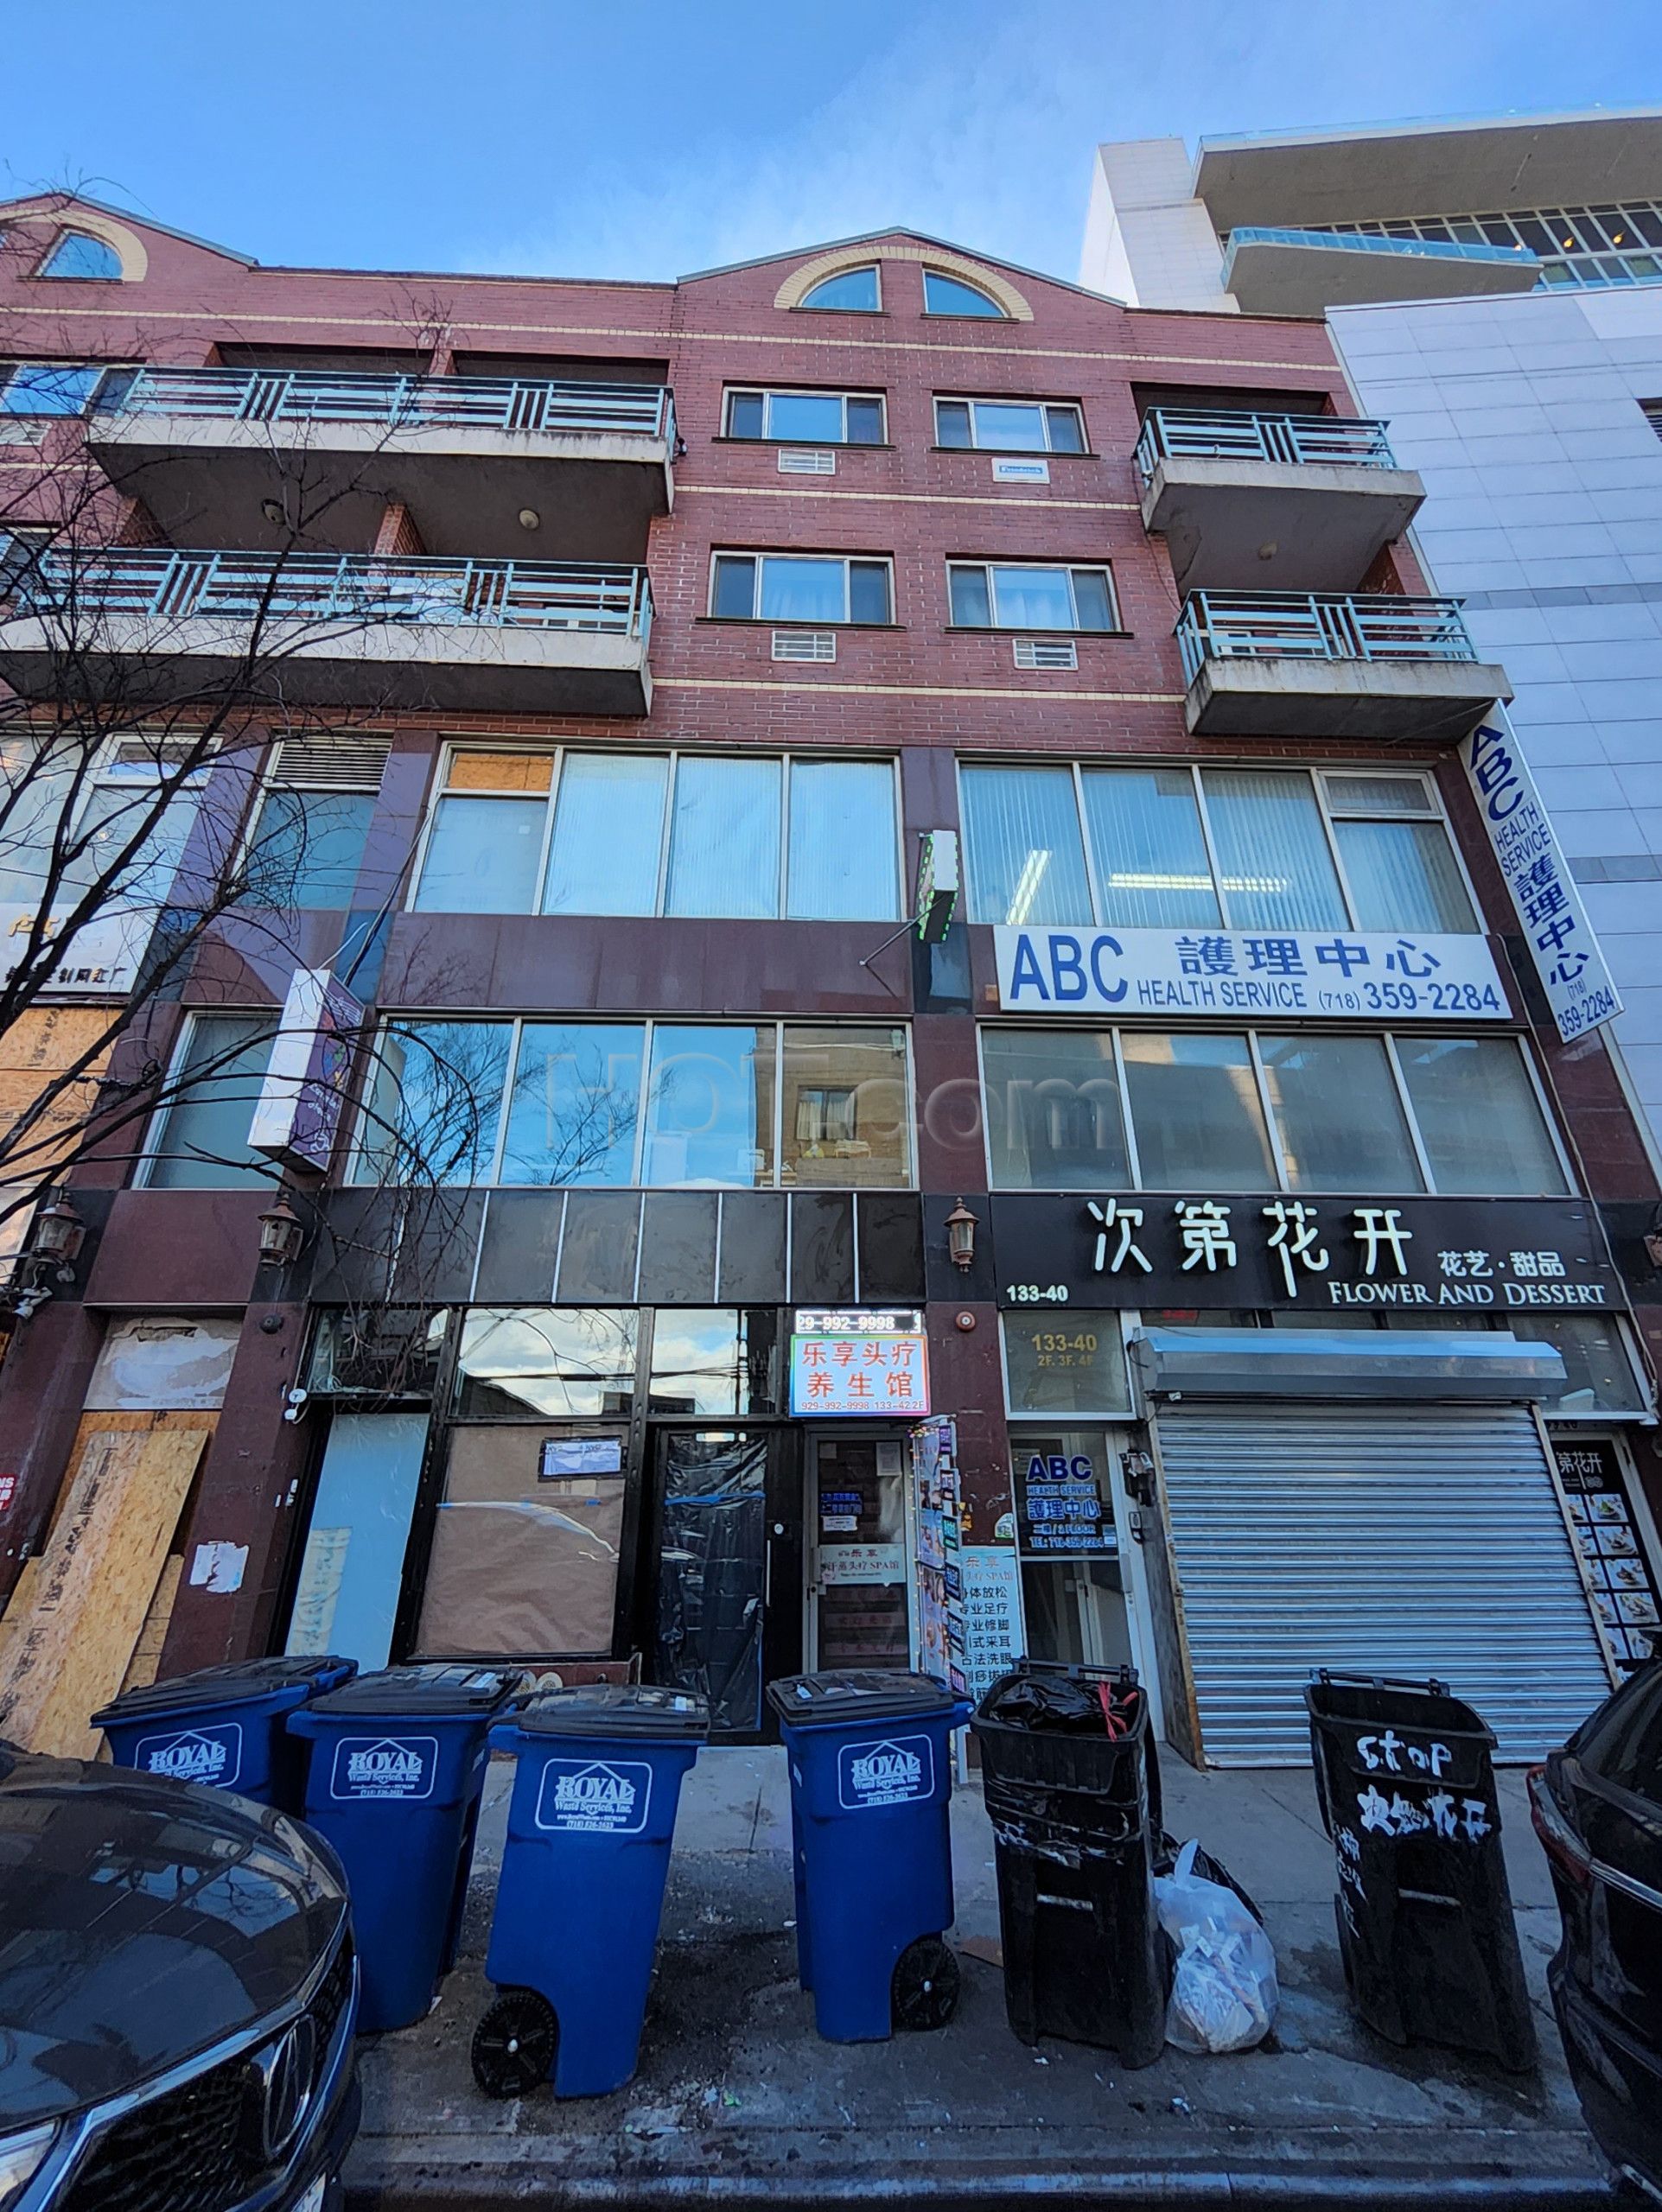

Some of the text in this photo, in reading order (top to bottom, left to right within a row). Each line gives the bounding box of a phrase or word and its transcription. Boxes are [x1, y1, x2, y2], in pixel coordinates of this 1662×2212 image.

[1470, 724, 1524, 822] ABC
[1494, 801, 1539, 854] HEALTH
[1502, 823, 1551, 877] SERVICE
[1513, 852, 1590, 985] 護理中心
[1009, 933, 1128, 1004] ABC
[1175, 935, 1442, 979] 護理中心
[1137, 978, 1500, 1012] HEALTH SERVICE (718) 359-2284
[1566, 977, 1587, 1001] (718)
[1557, 985, 1615, 1037] 359-2284
[1086, 1198, 1413, 1298] 次第花开
[1006, 1283, 1069, 1303] 133-40
[1329, 1281, 1605, 1306] FLOWER AND DESSERT
[802, 1341, 917, 1368] 乐享头疗
[1031, 1333, 1098, 1352] 133-40
[807, 1370, 914, 1398] 养生馆
[801, 1401, 869, 1410] 929-992-9998
[1027, 1456, 1092, 1481] ABC
[1027, 1484, 1096, 1496] HEALTH SERVICE
[1027, 1498, 1101, 1520] 護理中心
[969, 1636, 1011, 1649] 式采耳
[149, 1740, 226, 1772] ROYAL
[349, 1752, 423, 1774] ROYAL
[852, 1752, 921, 1778] ROYAL
[555, 1776, 636, 1803] ROYAL
